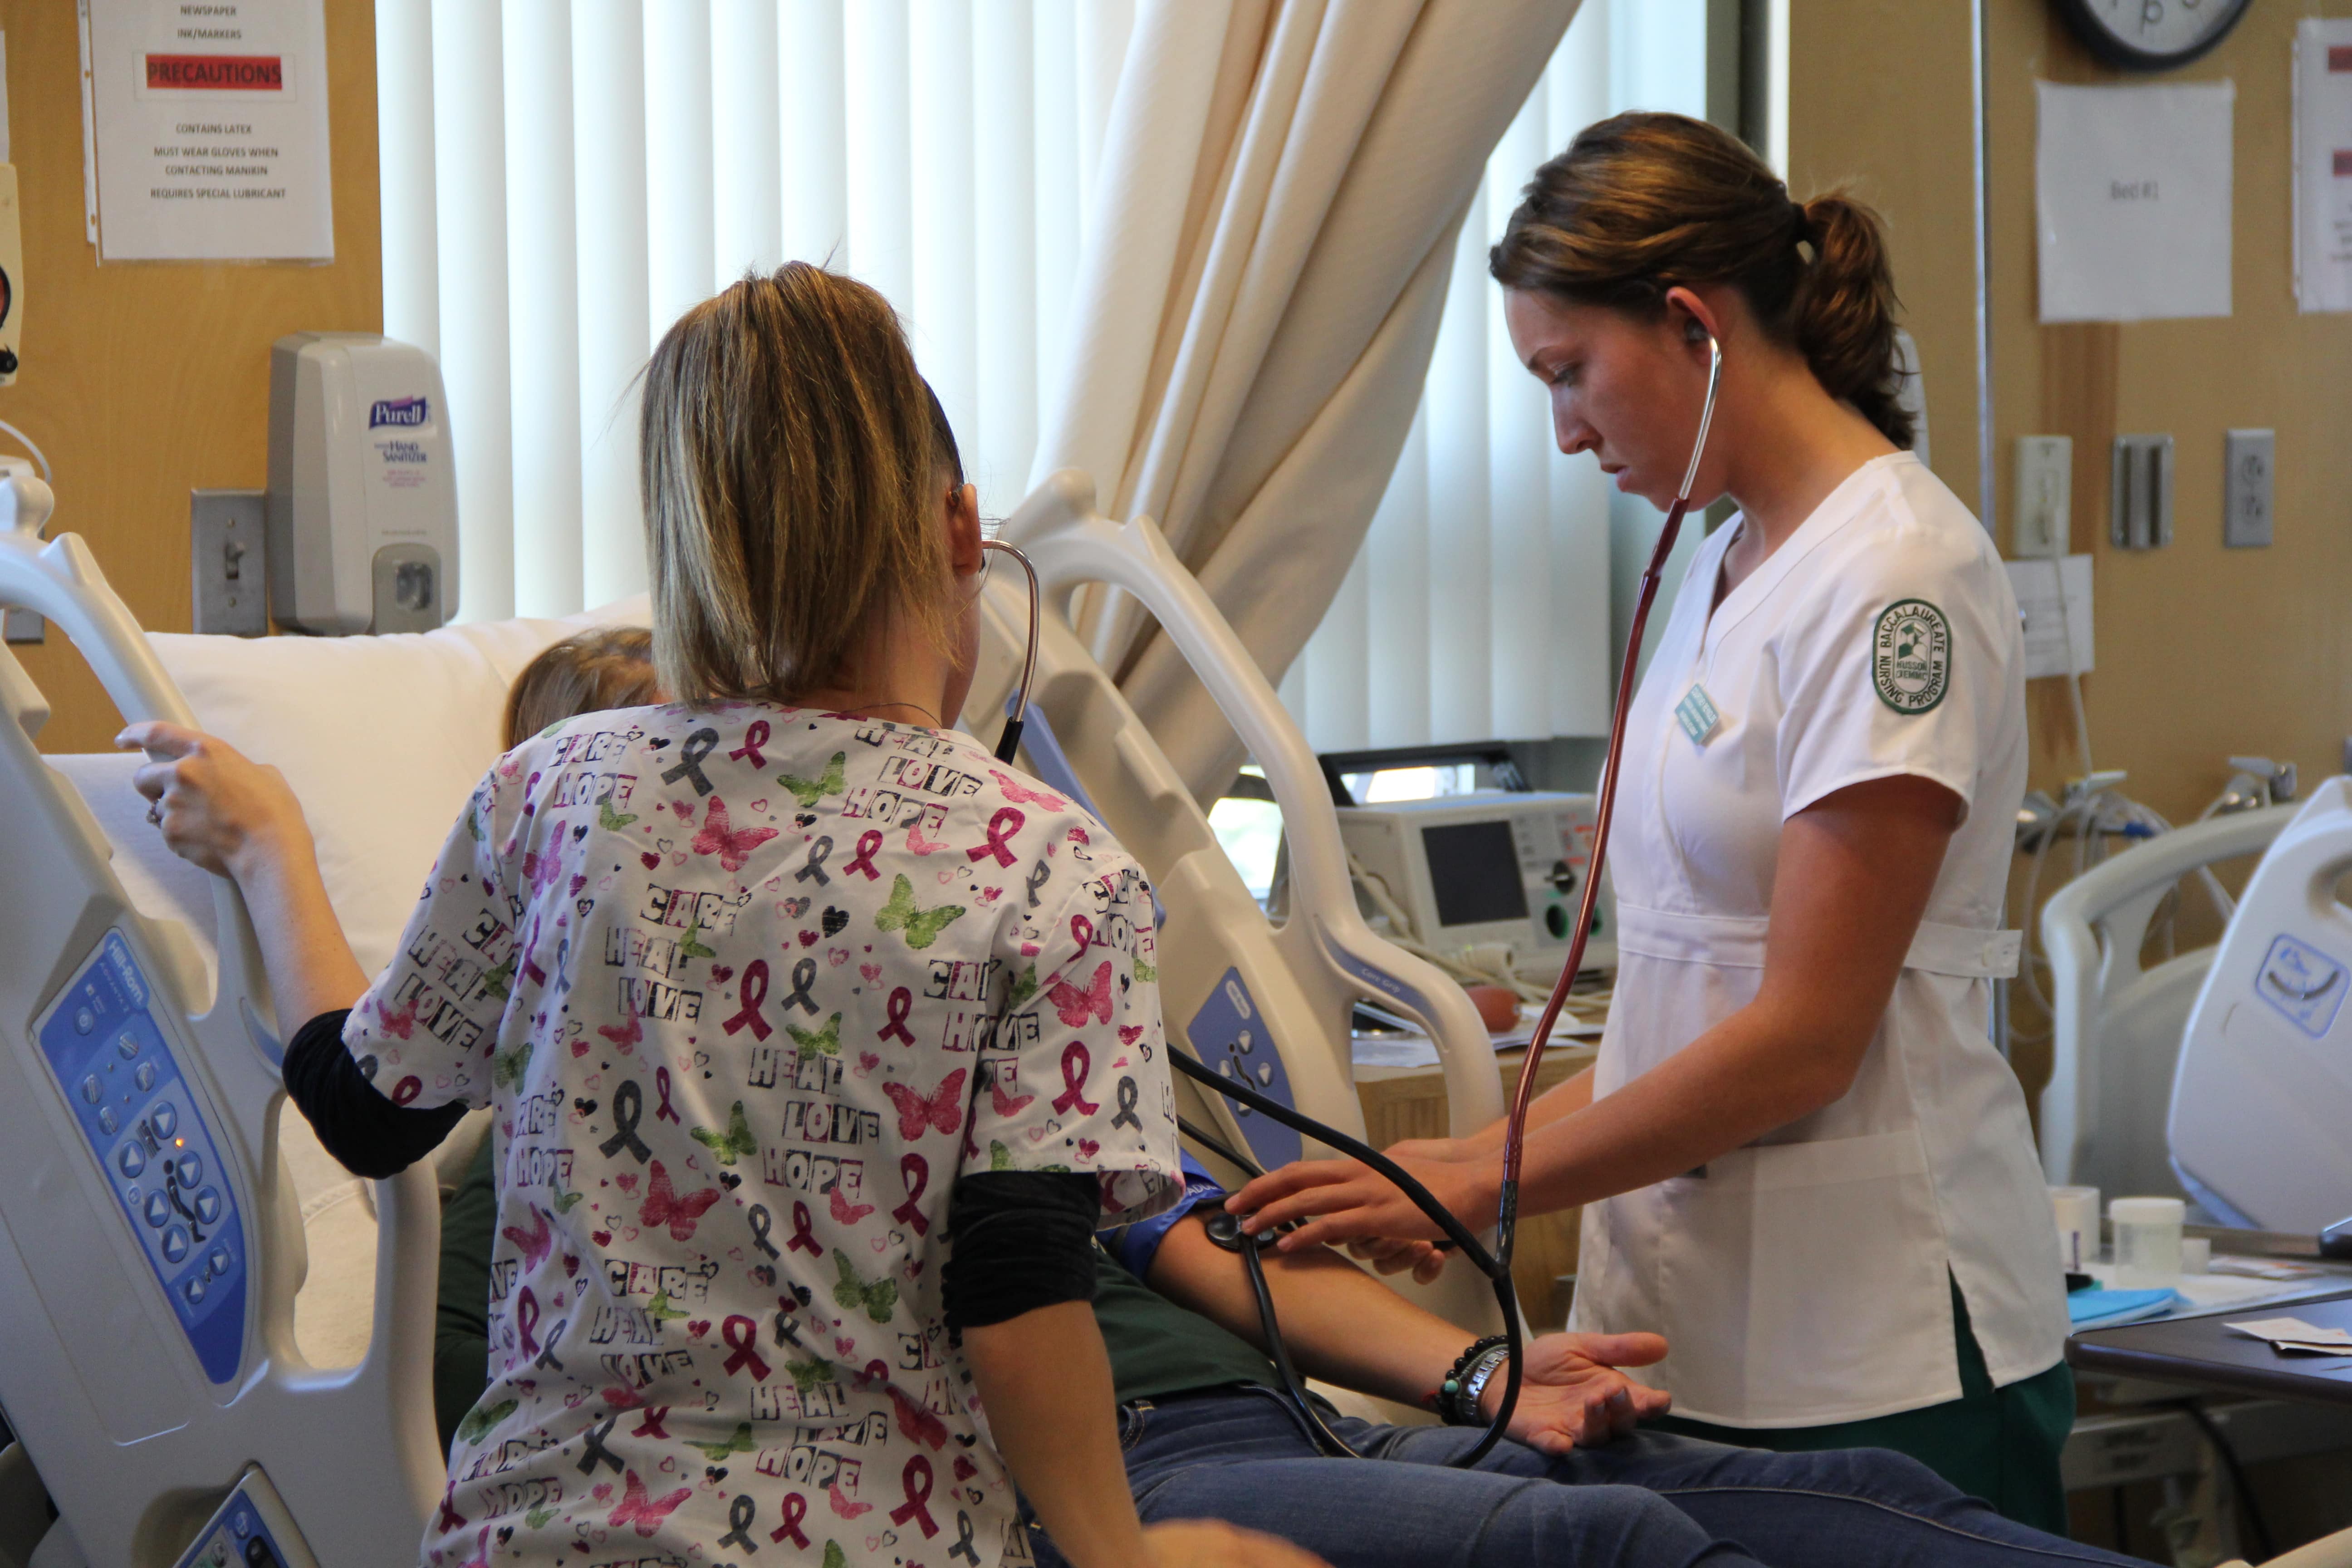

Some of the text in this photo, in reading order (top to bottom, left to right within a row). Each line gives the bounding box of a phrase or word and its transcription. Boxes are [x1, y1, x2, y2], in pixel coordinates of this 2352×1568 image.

[180, 5, 236, 16] NEWSPAPER
[177, 29, 242, 39] INK/MARKERS
[147, 63, 281, 83] PRECAUTIONS
[176, 123, 251, 134] CONTAINS LATEX
[154, 147, 278, 157] MUST WEAR GLOVES WHEN
[165, 165, 268, 176] CONTACTING MANIKIN
[151, 188, 286, 199] REQUIRES SPECIAL LUBRICANT
[1880, 605, 1945, 652] BACCALAUREATE
[1879, 656, 1943, 706] NURSING PROGRAM
[552, 772, 638, 809] HOPE
[877, 756, 983, 797] LOVE
[841, 788, 949, 838] HOPE
[639, 883, 739, 937] CARE
[407, 925, 492, 1012] HEAL
[604, 926, 695, 982] HEAL
[393, 972, 484, 1054] LOVE
[618, 977, 703, 1024] LOVE
[748, 1047, 844, 1097] HEAL
[781, 1101, 880, 1145] LOVE
[516, 1147, 574, 1188] HOPE
[762, 1147, 863, 1199] HOPE
[604, 1259, 708, 1304] CARE
[589, 1306, 664, 1346] HEAL
[750, 1382, 850, 1421] HEAL
[755, 1445, 862, 1497] HOPE
